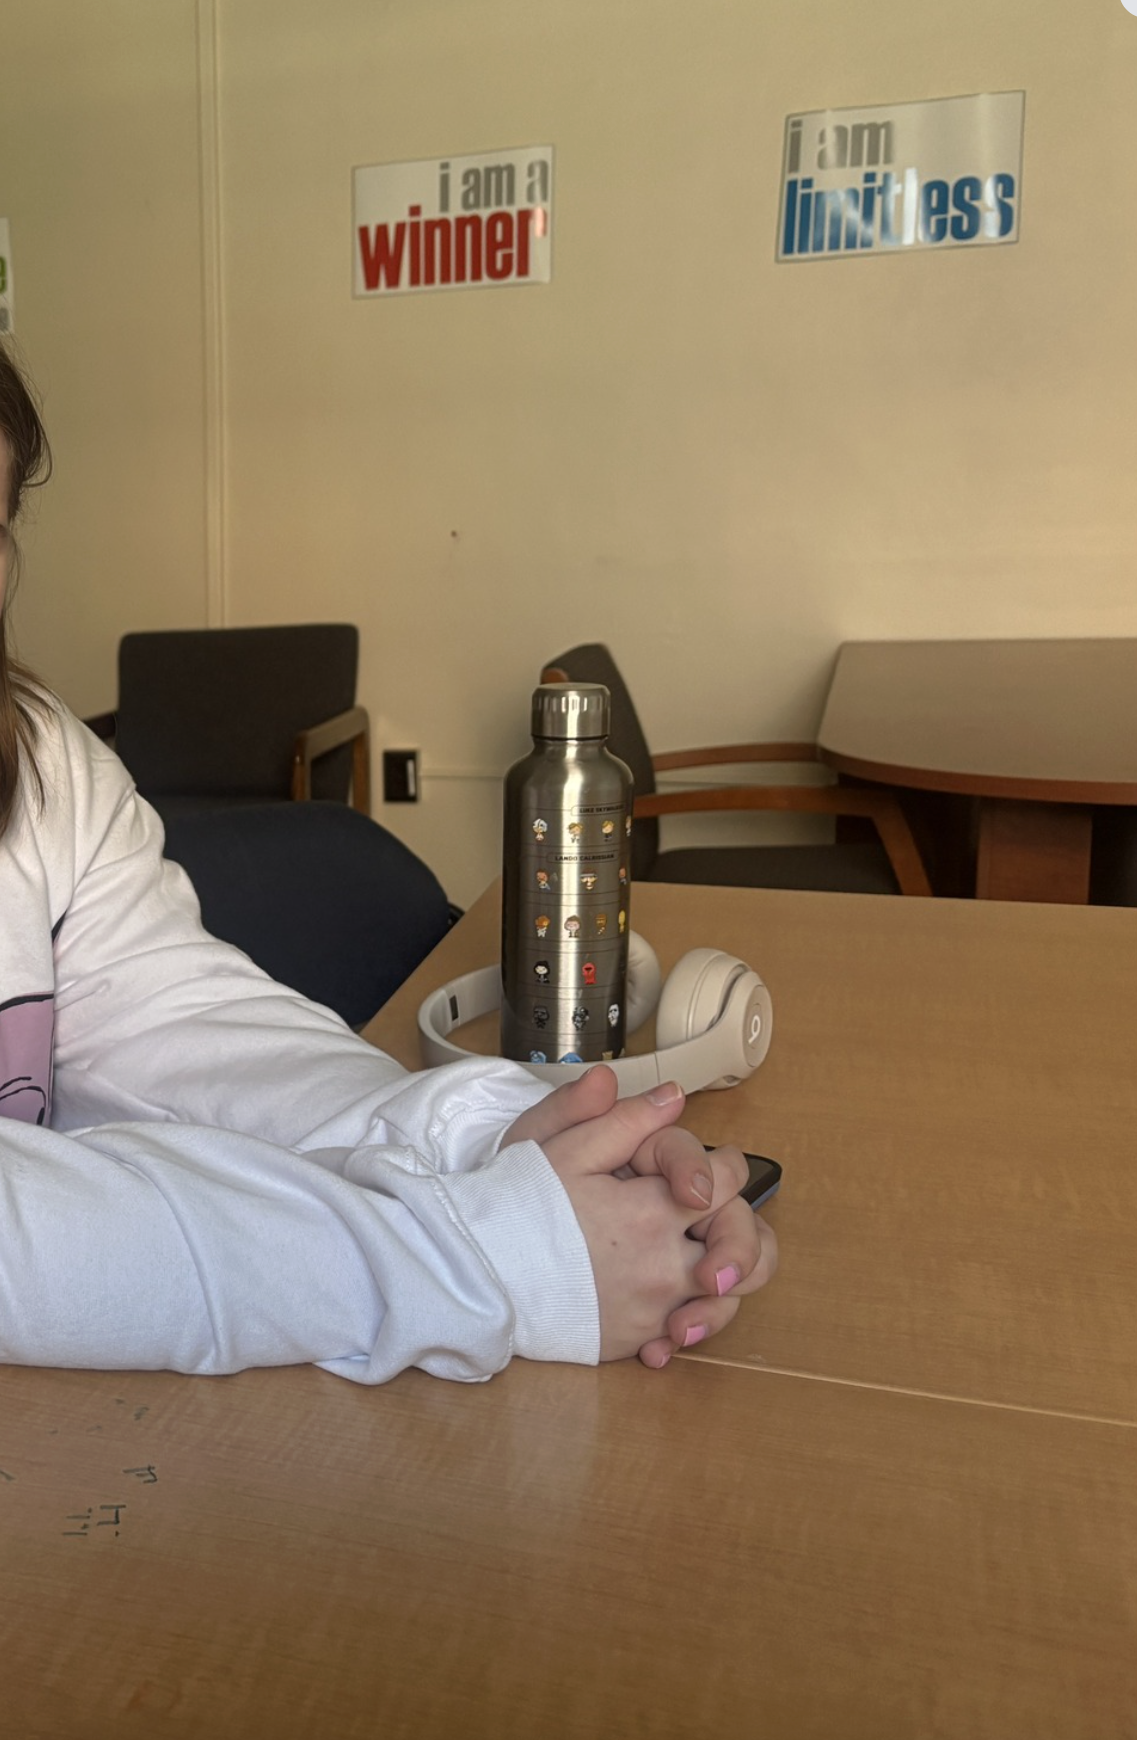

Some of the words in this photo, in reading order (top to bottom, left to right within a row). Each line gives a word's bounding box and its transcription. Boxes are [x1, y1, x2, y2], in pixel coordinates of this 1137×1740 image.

[788, 119, 803, 174] i
[816, 120, 894, 171] am
[440, 162, 450, 214] i
[462, 163, 516, 211] am
[526, 160, 549, 204] a
[782, 167, 1016, 256] limitless
[358, 205, 547, 291] winner
